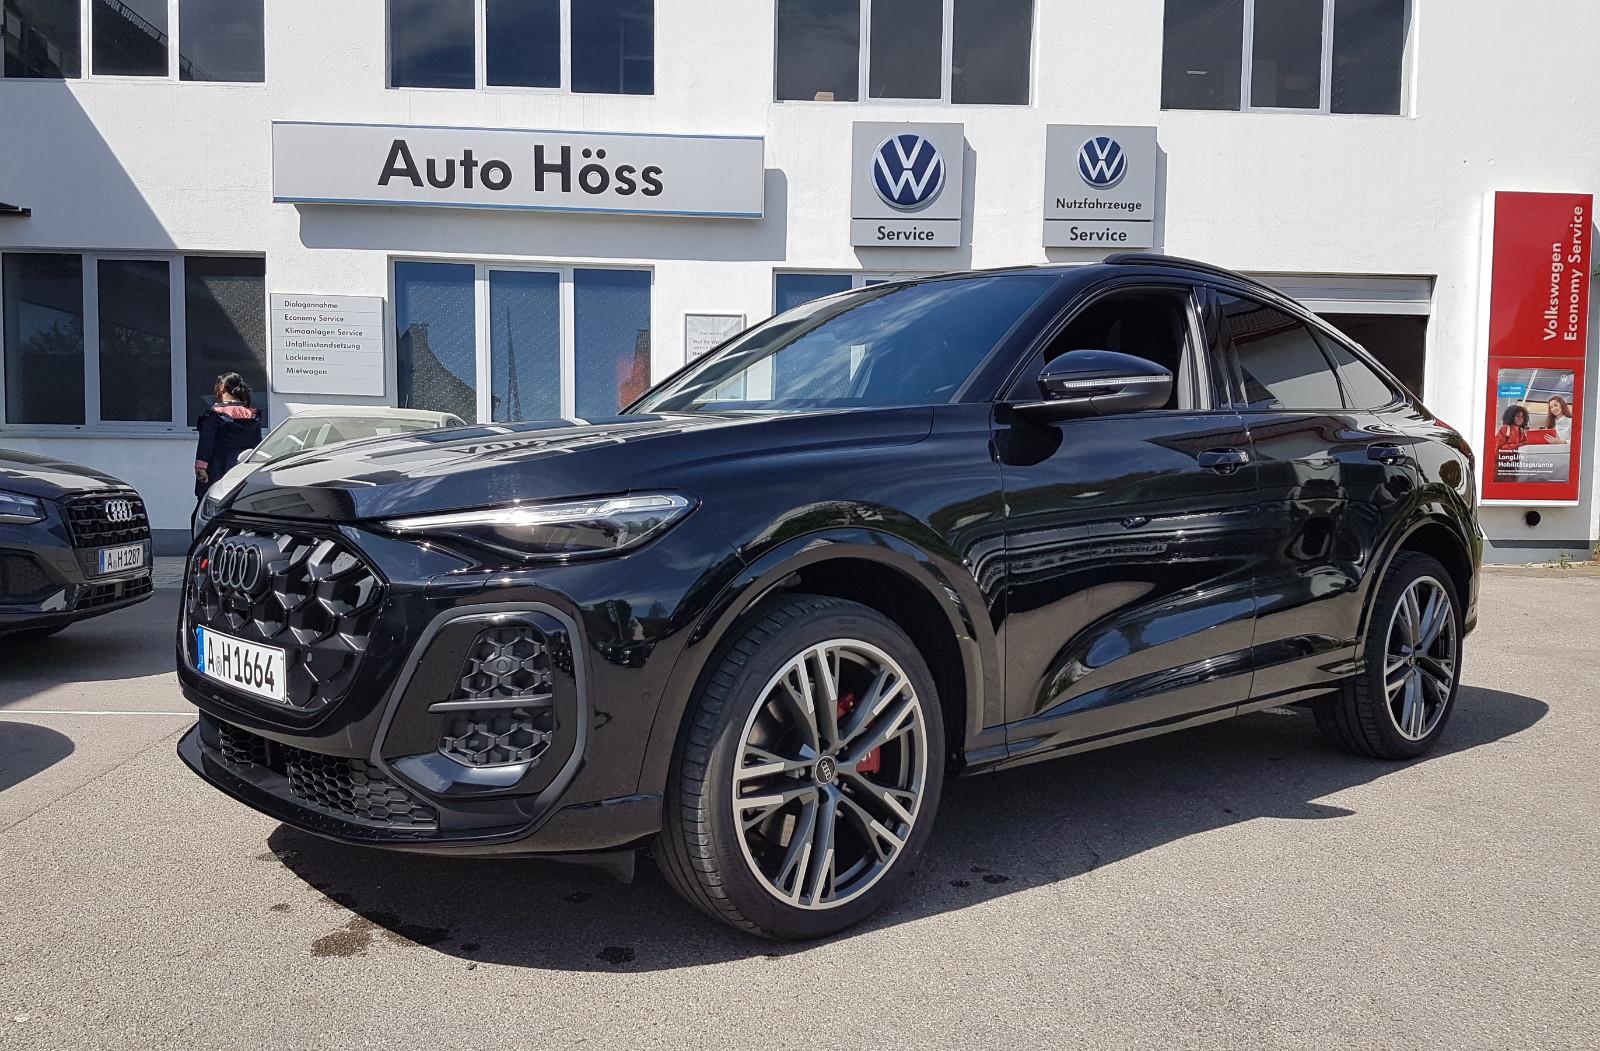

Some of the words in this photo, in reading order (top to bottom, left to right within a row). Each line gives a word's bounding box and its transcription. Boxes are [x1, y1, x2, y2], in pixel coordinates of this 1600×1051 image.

[377, 139, 513, 191] Auto
[533, 143, 664, 197] Höss
[1056, 198, 1142, 213] Nutzfahrzeuge
[877, 225, 935, 241] Service
[1069, 226, 1128, 242] Service
[1568, 206, 1584, 263] Service
[1543, 242, 1564, 341] Volkswagen
[284, 300, 339, 309] Dialogannahme
[1564, 269, 1584, 341] Economy
[284, 314, 317, 322] Economy
[285, 327, 335, 337] Klimaanlagen
[337, 328, 363, 337] Service
[285, 340, 361, 351] Unfallinstandsetzung
[285, 353, 325, 362] Lackiererei
[286, 367, 327, 376] Mietwagen
